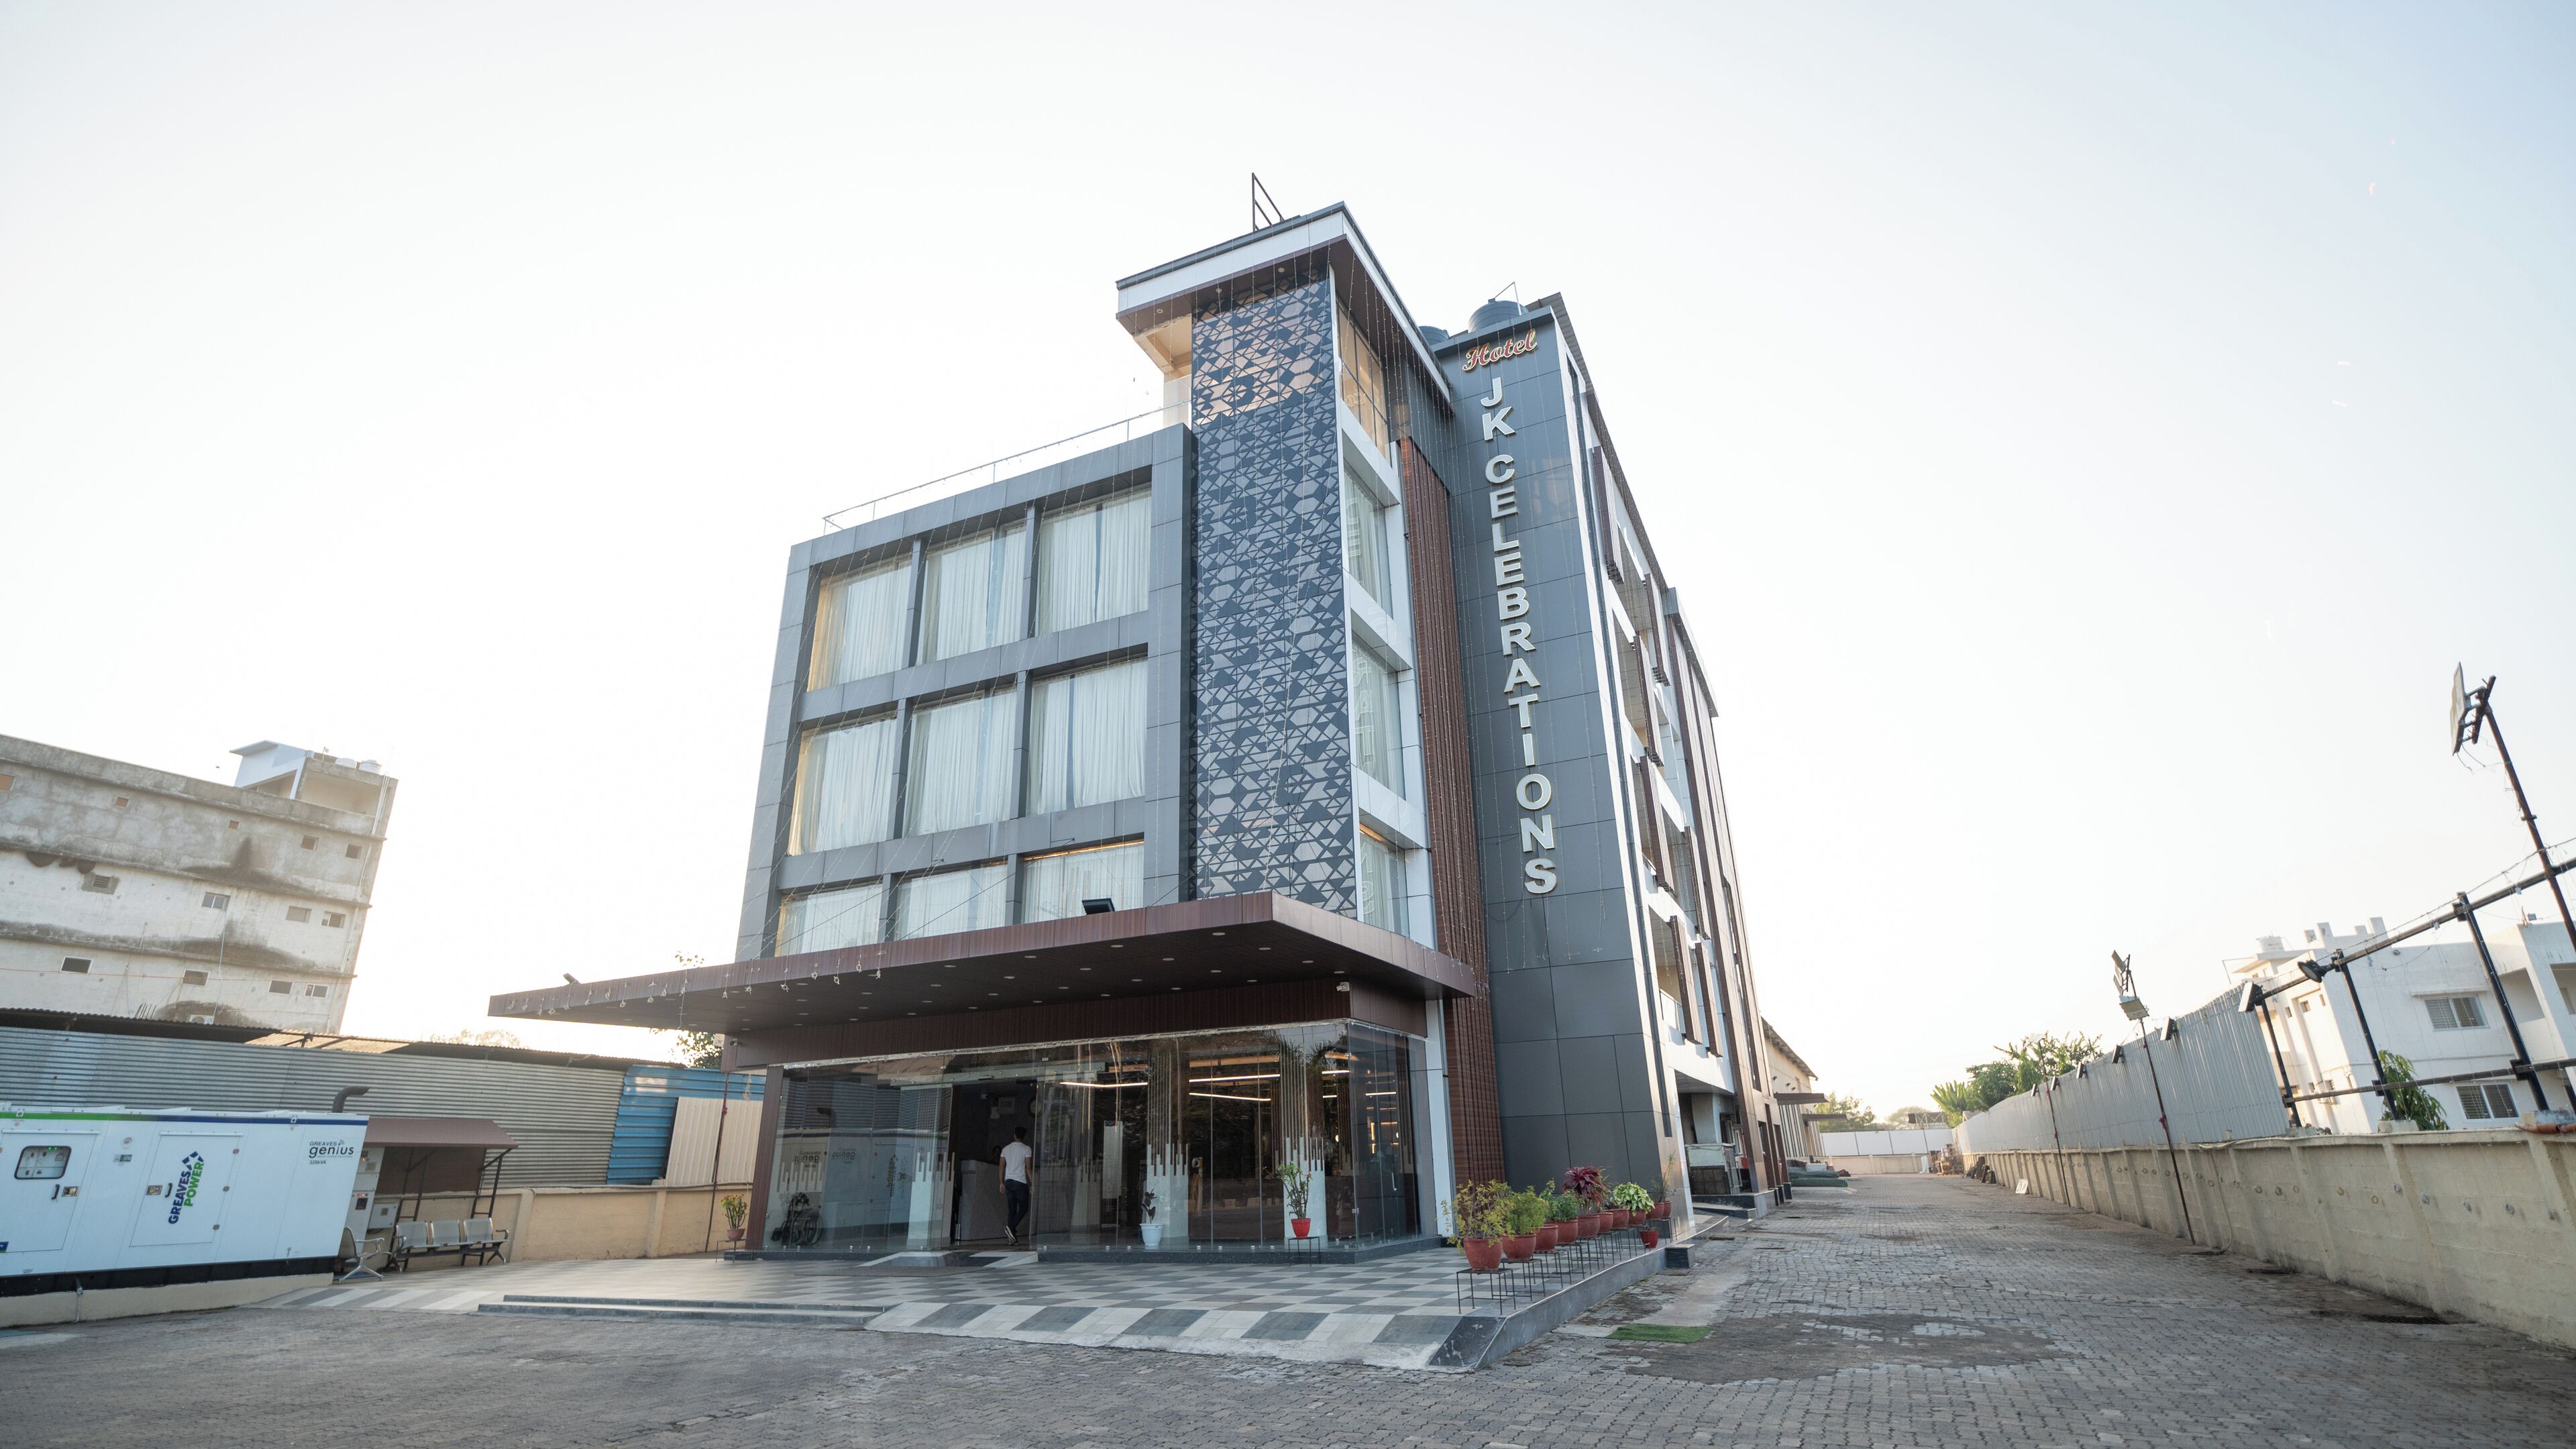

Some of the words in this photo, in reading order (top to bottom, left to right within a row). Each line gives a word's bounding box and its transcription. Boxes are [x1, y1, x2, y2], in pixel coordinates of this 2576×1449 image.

[1462, 328, 1539, 371] Hotel
[1481, 377, 1517, 441] JK
[1485, 454, 1557, 894] CELEBRATIONS
[309, 1143, 354, 1159] genius
[168, 1171, 191, 1224] GREAVES
[183, 1161, 205, 1207] POWER
